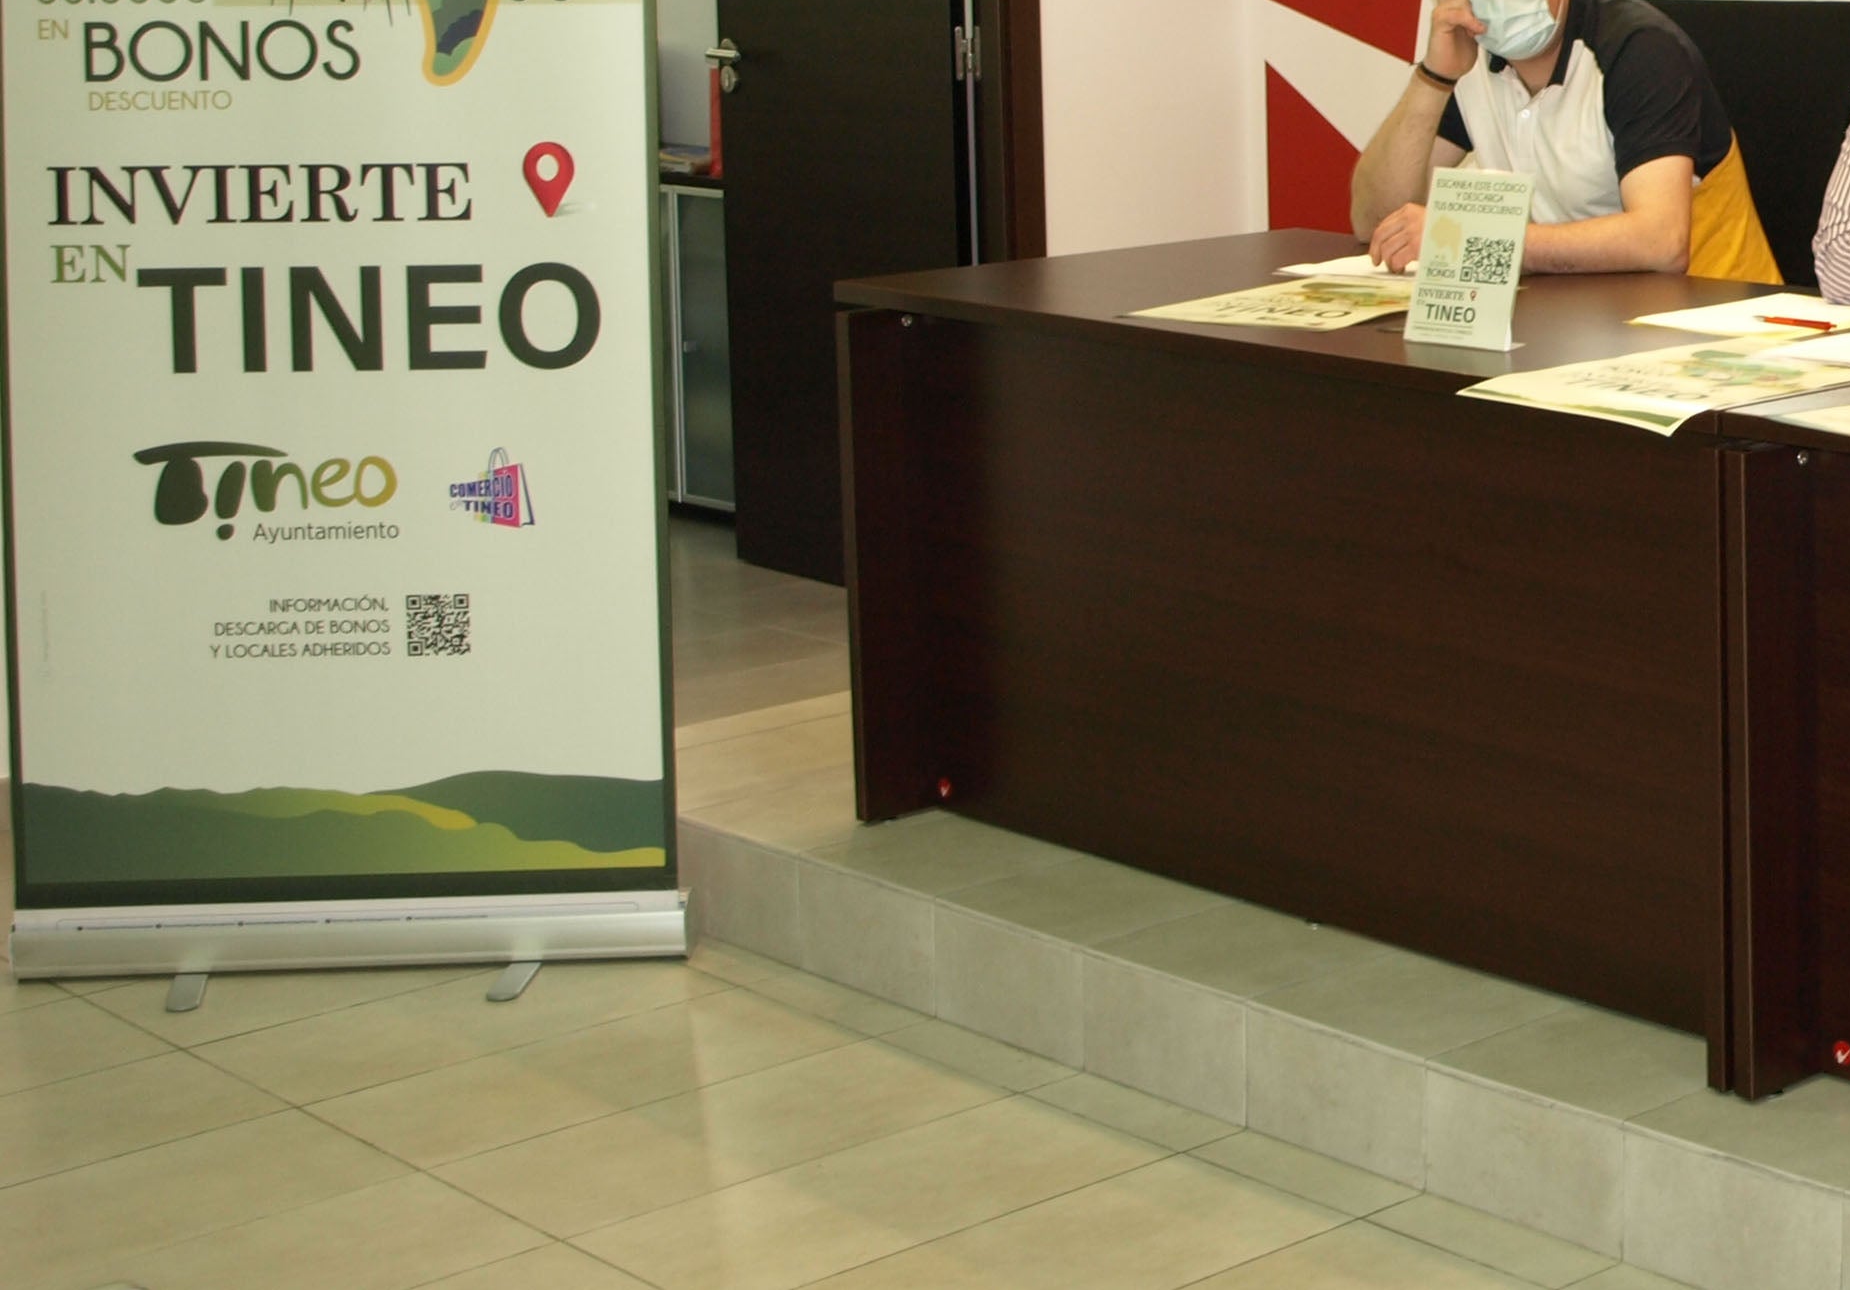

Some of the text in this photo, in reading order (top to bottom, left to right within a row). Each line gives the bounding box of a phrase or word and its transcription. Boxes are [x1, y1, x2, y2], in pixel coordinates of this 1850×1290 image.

[38, 18, 361, 83] EN BONOS
[88, 89, 233, 112] DESCUENTO
[46, 162, 473, 226] INVIERTE
[50, 244, 601, 374] EN TINEO
[1425, 303, 1476, 324] TINEO
[449, 474, 514, 498] COMERCIO
[462, 500, 514, 519] TINEO
[252, 521, 400, 545] Ayuntamiento
[214, 619, 391, 637] DESCARGA DE BONOS
[209, 641, 392, 659] Y LOCALES ADHERIDOS
